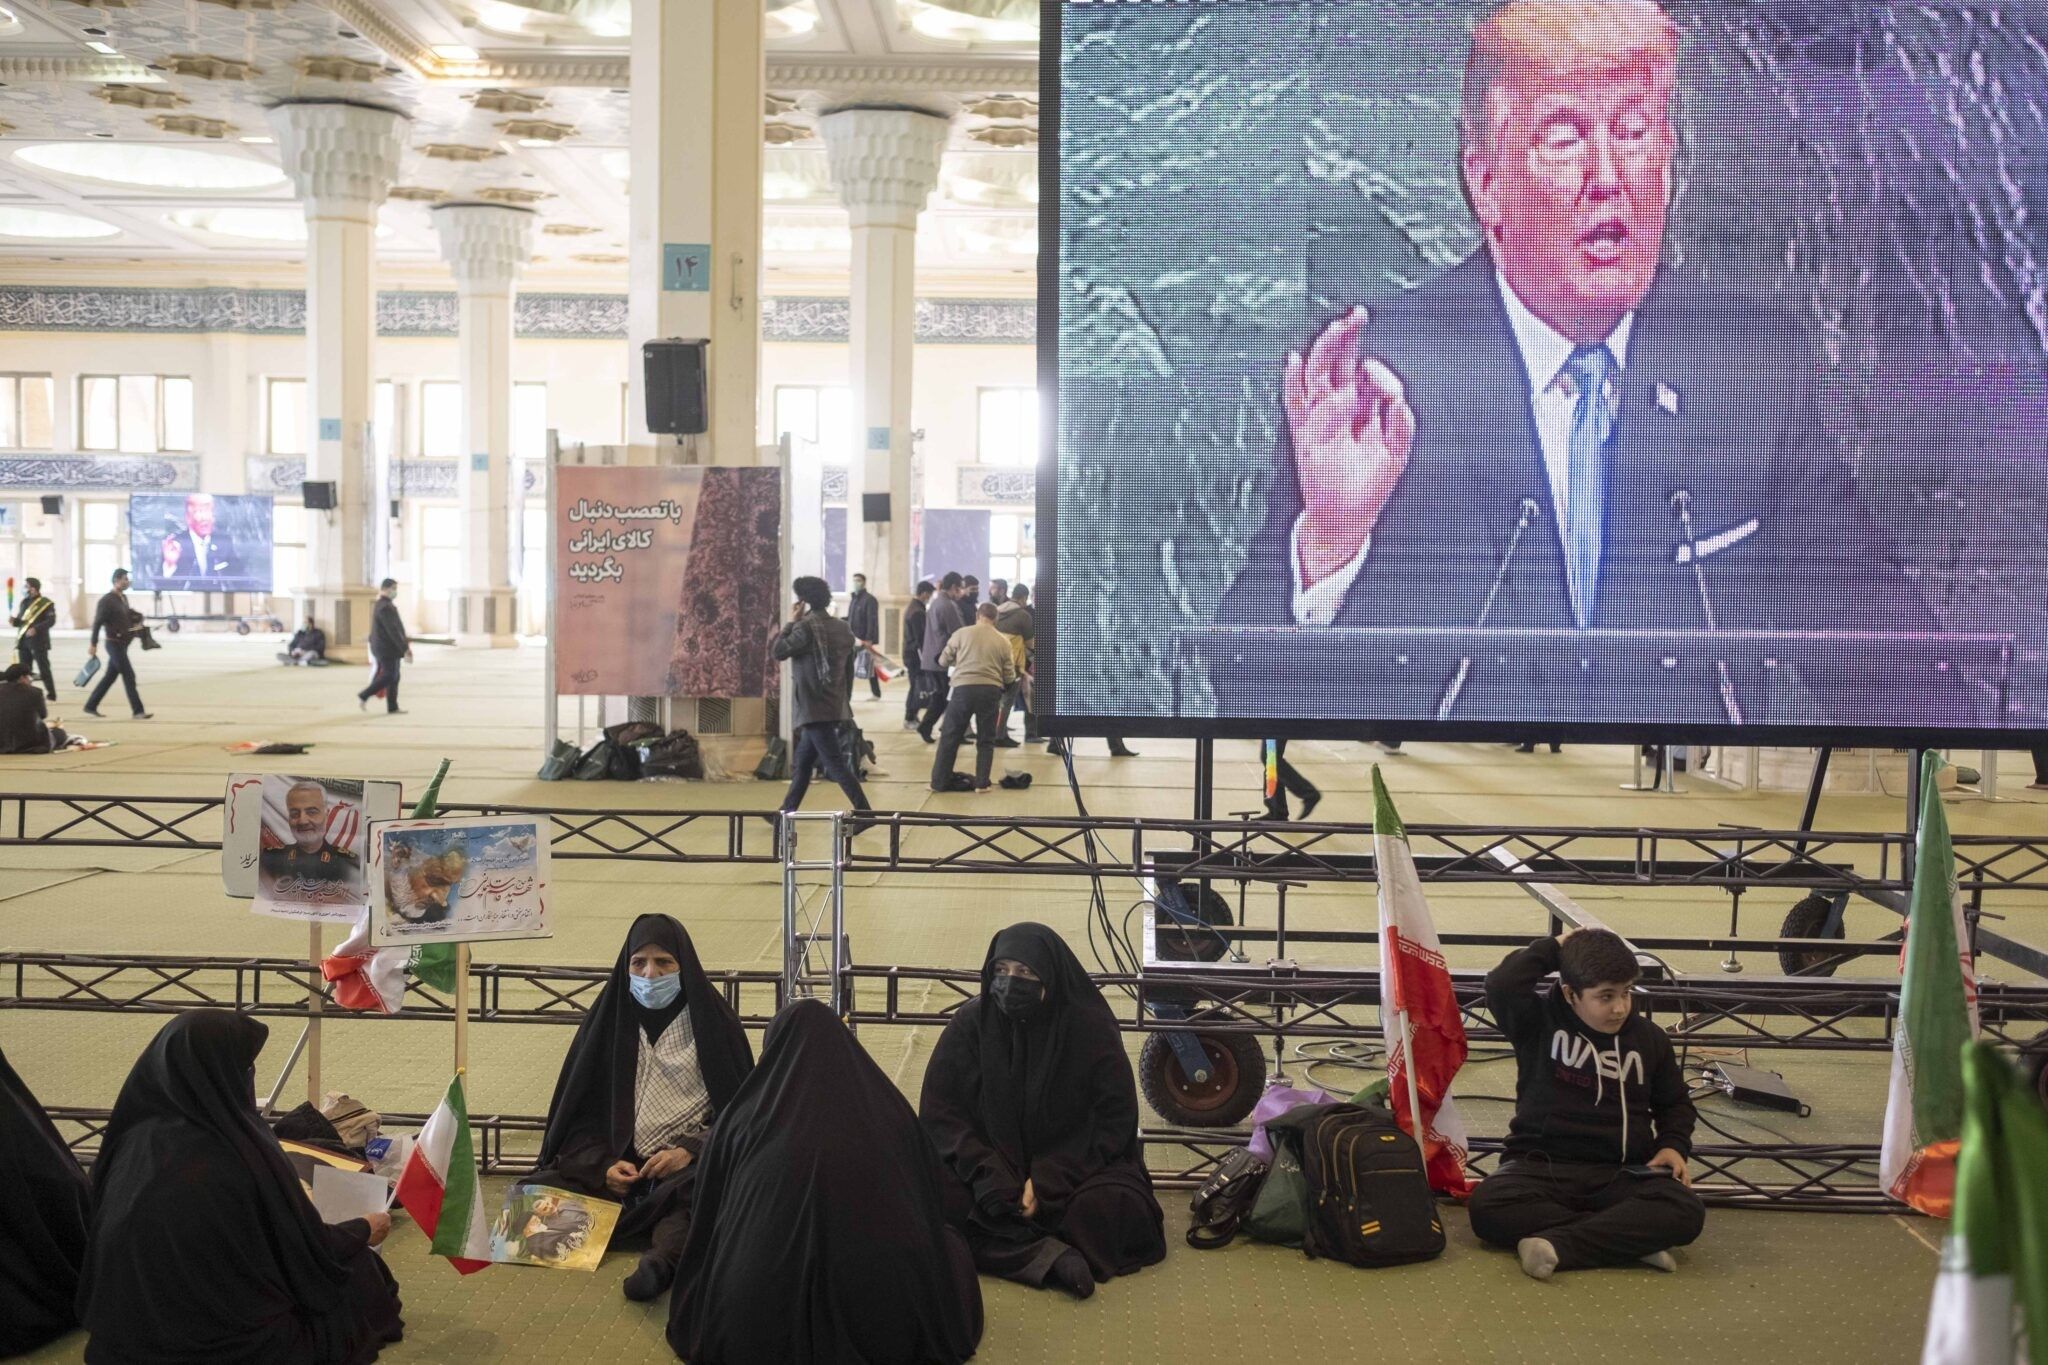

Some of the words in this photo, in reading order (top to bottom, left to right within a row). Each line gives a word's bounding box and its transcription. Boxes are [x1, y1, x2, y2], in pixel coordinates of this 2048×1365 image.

[676, 256, 698, 277] ۱۴
[569, 498, 614, 525] دنبال
[614, 500, 669, 525] تعصب
[668, 499, 682, 525] با
[569, 529, 612, 554] ایرانی
[611, 529, 654, 552] کالای
[569, 556, 624, 583] بگردید
[1551, 1029, 1645, 1085] NASA
